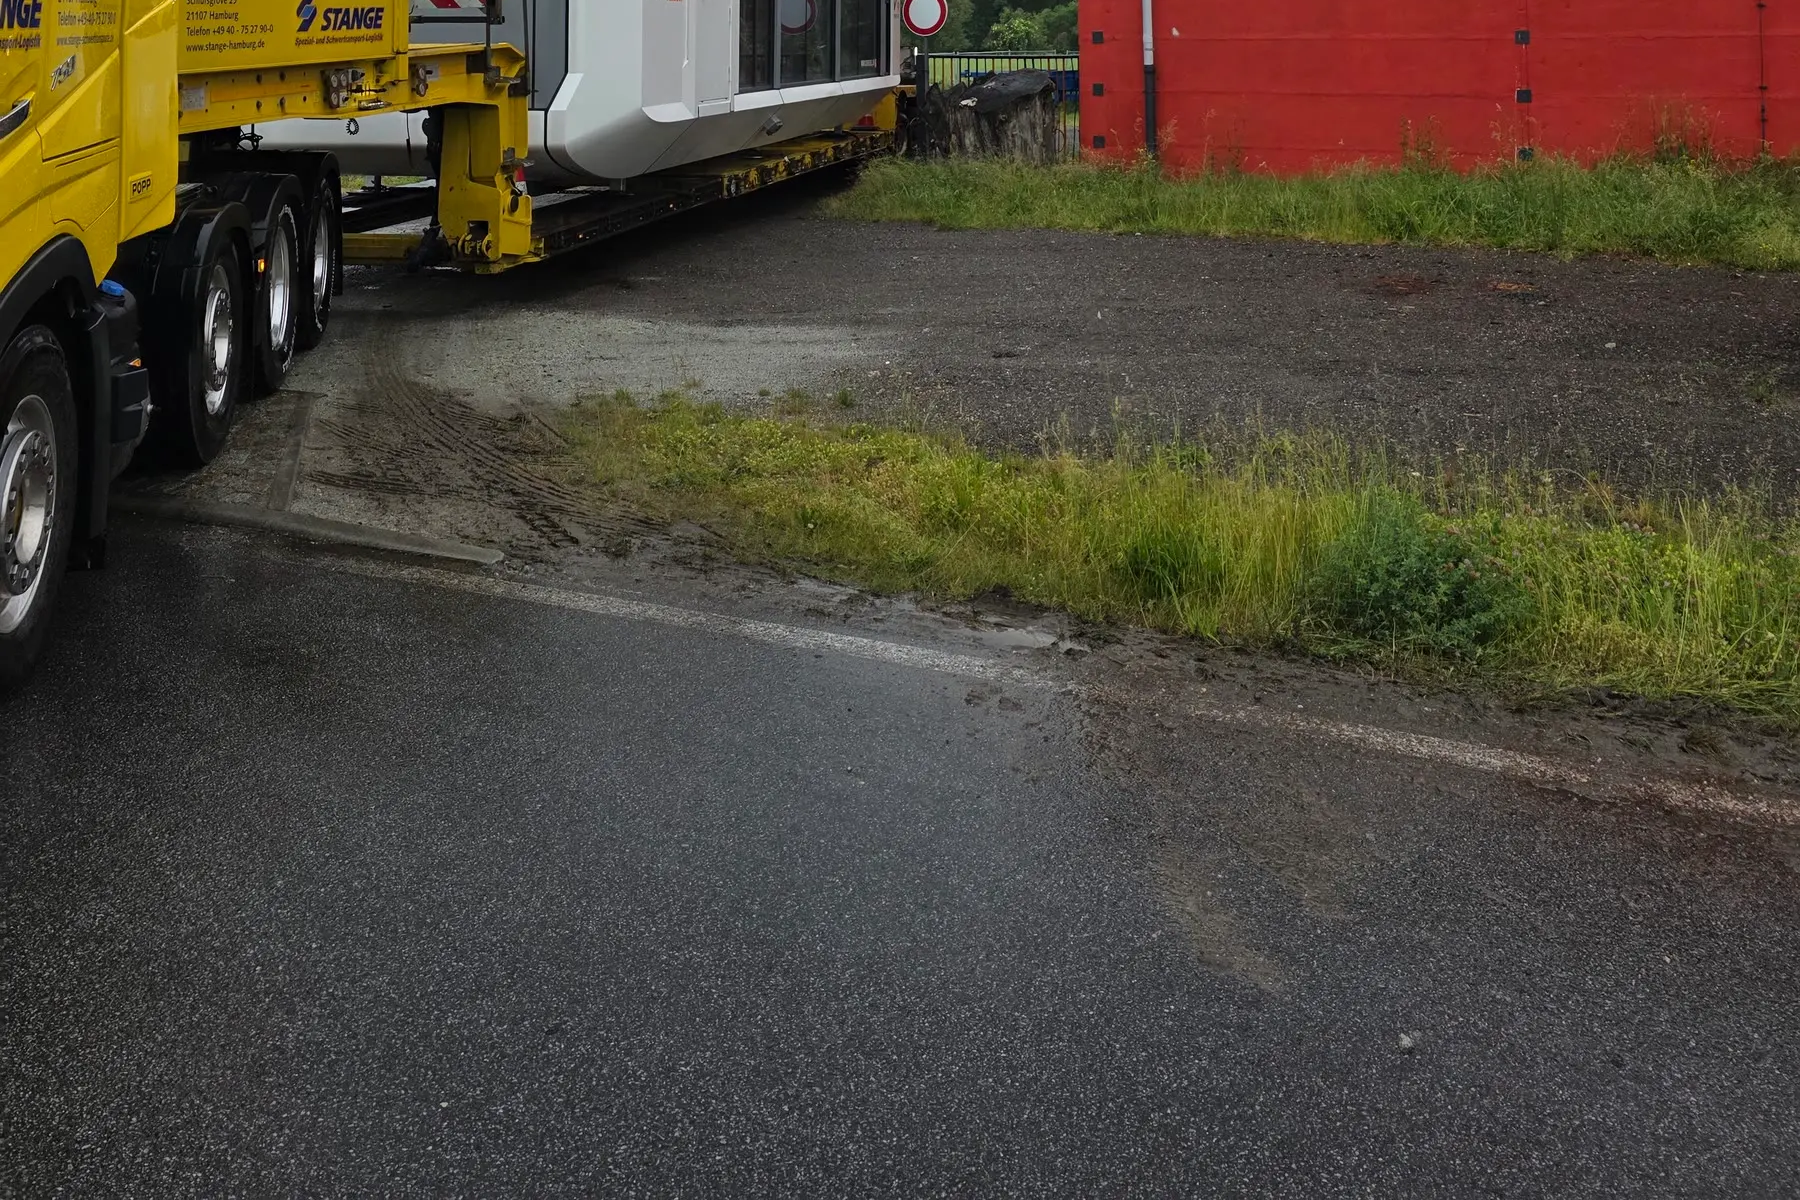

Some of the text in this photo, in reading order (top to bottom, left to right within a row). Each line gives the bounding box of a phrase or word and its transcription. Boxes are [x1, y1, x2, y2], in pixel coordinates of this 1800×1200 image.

[58, 11, 76, 26] Telefon
[186, 10, 239, 21] 21107 Hamburg
[320, 7, 384, 31] STANGE
[186, 26, 210, 36] Telefon
[213, 26, 224, 35] +49
[226, 26, 235, 34] 40
[241, 25, 249, 34] 75
[250, 25, 257, 33] 27
[259, 24, 273, 33] 90-0
[0, 33, 42, 51] sport-Logistik
[186, 39, 265, 53] www.stange-hamburg.de
[132, 178, 151, 196] POPP
